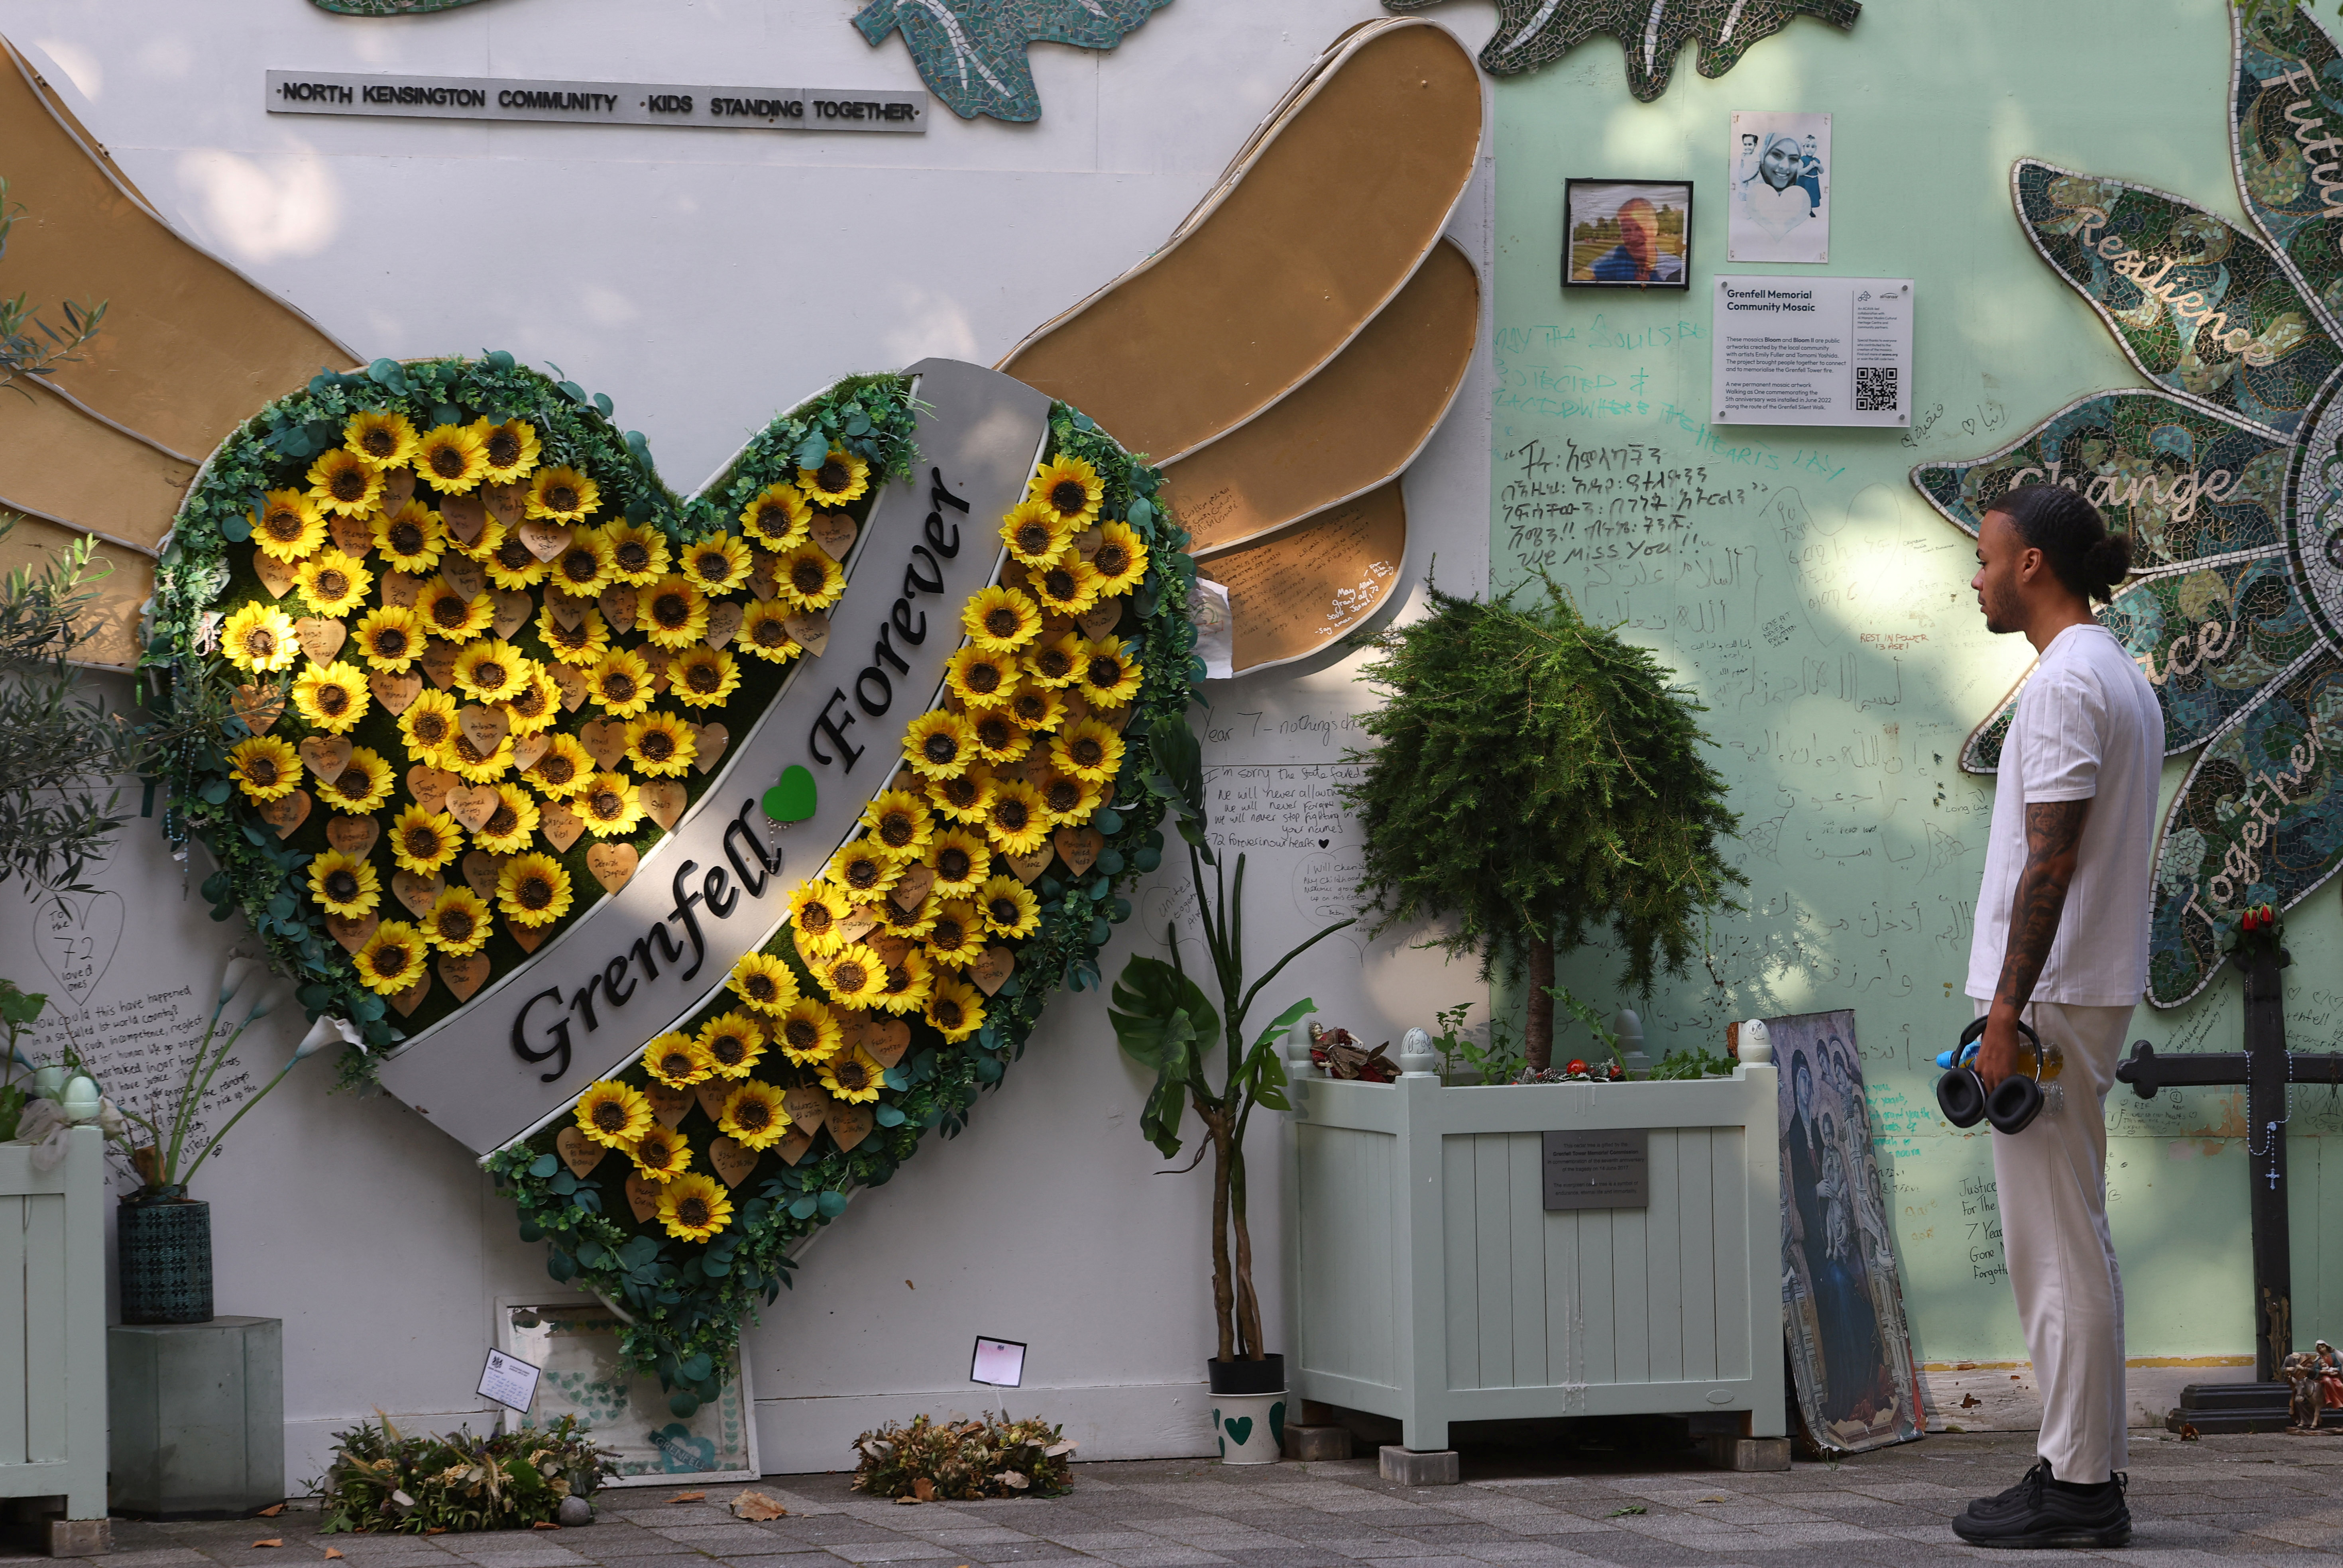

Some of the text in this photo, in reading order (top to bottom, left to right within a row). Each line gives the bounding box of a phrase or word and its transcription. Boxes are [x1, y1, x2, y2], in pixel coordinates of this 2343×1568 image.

[283, 82, 914, 121] NORTH KENSINGTON COMMUNITY KIDS STANDING TOGETHER
[1727, 289, 1812, 299] Grenfell Memorial
[2068, 205, 2277, 367] Resilience
[1727, 302, 1815, 313] Community Mosaic
[1337, 578, 1375, 600] May Allah
[1358, 589, 1368, 600] all
[1369, 585, 1380, 594] 72
[808, 465, 971, 775] Forever
[1860, 633, 1880, 643] REST
[1884, 633, 1893, 642] IN
[1200, 705, 1234, 749] Year
[1237, 712, 1263, 737] 7
[2182, 716, 2323, 926] Together
[511, 797, 782, 1084] Grenfell
[53, 937, 94, 969] 72
[61, 964, 93, 981] loved
[67, 979, 87, 991] ones
[1959, 1175, 1997, 1197] Justice
[1962, 1193, 1996, 1216] For The
[1965, 1222, 1979, 1240] 7
[1970, 1246, 1995, 1262] Gone
[1973, 1263, 2009, 1285] Forgott
